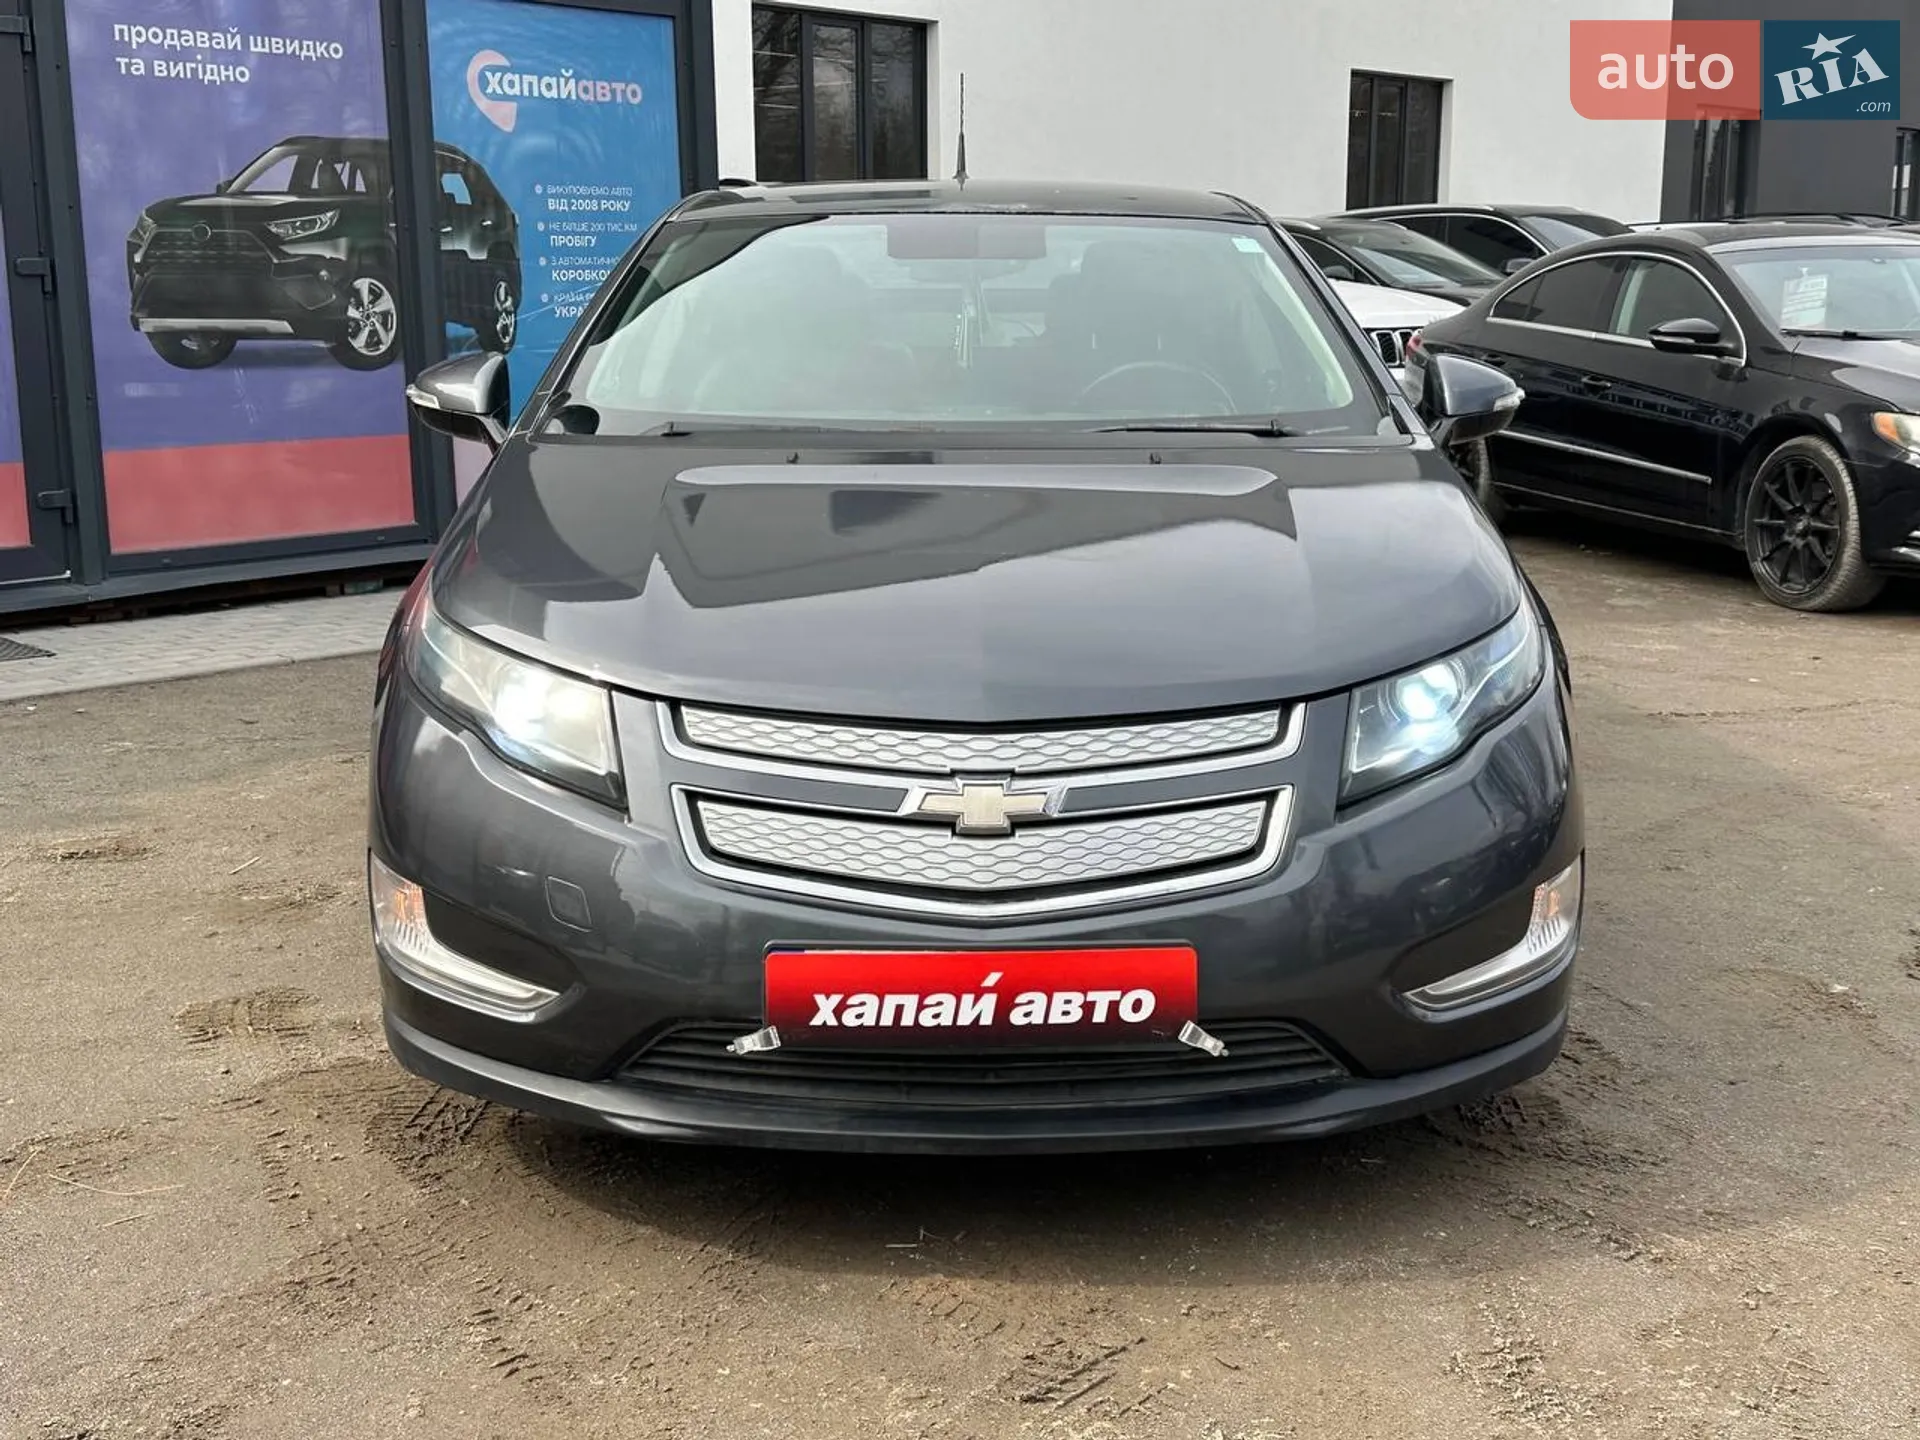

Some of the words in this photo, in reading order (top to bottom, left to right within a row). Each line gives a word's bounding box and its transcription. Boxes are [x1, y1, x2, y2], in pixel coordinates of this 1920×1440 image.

[113, 24, 241, 50] продавай
[249, 35, 344, 61] швидко
[115, 56, 145, 76] та
[153, 54, 250, 85] вигідно
[547, 198, 568, 212] ВІД
[601, 200, 631, 212] РОКУ
[550, 235, 597, 248] ПРОБІГУ
[558, 256, 620, 266] АВТОМАТИЧНО
[551, 269, 611, 282] КОРОБКО
[809, 971, 1004, 1027] хапай
[1009, 987, 1157, 1025] авто
